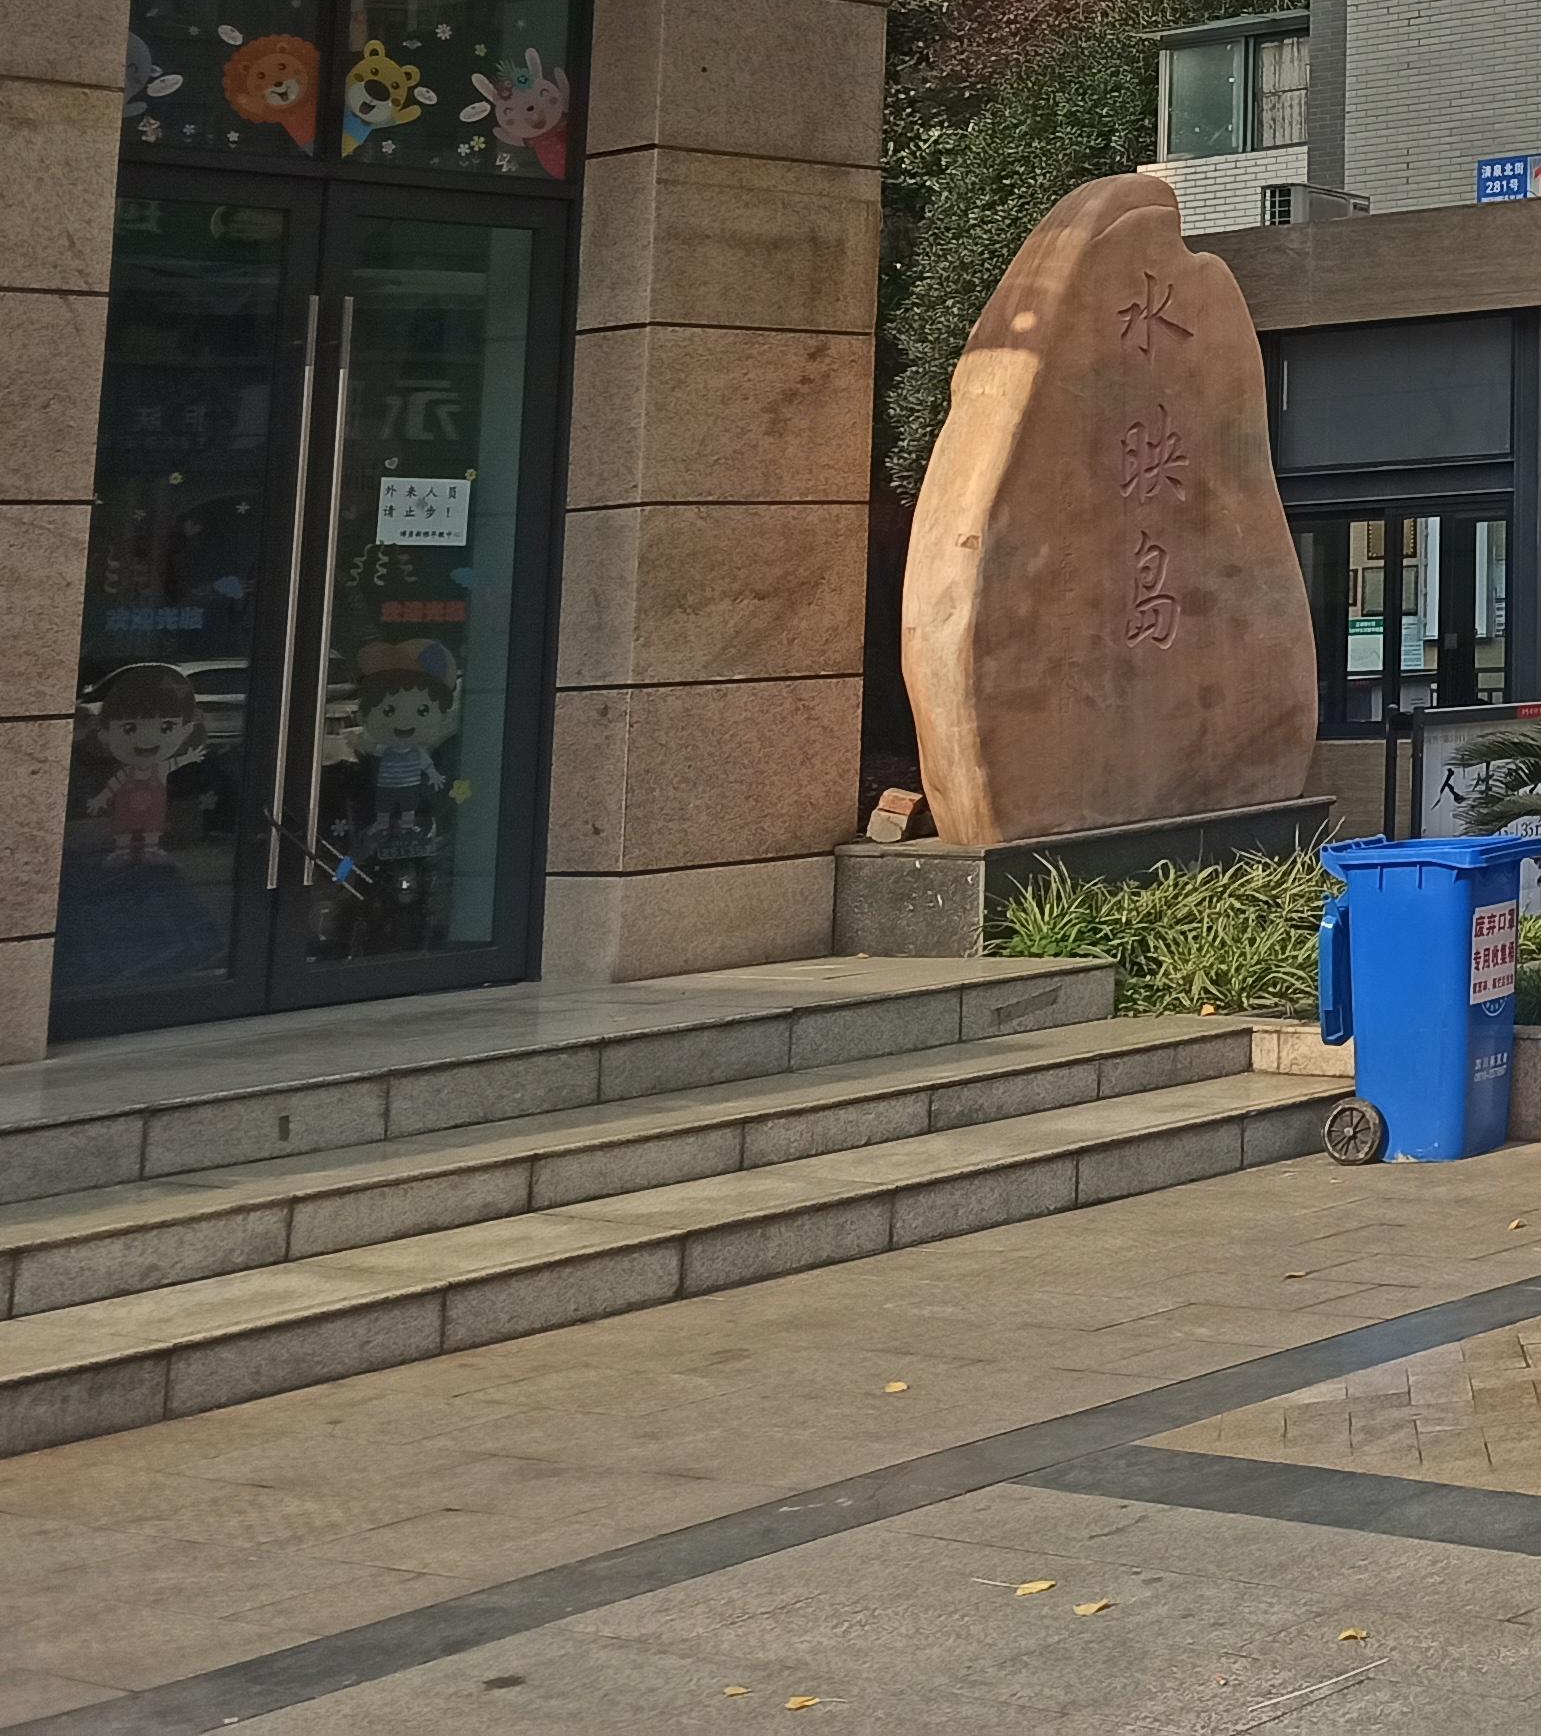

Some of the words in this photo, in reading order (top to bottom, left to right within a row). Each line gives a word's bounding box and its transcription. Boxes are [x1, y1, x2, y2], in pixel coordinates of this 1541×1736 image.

[1485, 179, 1518, 193] 281号
[1118, 270, 1194, 652] 水映岛
[384, 484, 458, 500] 外来人员
[1474, 908, 1515, 938] 废弃口罩
[1472, 941, 1515, 972] 专用收集桶
